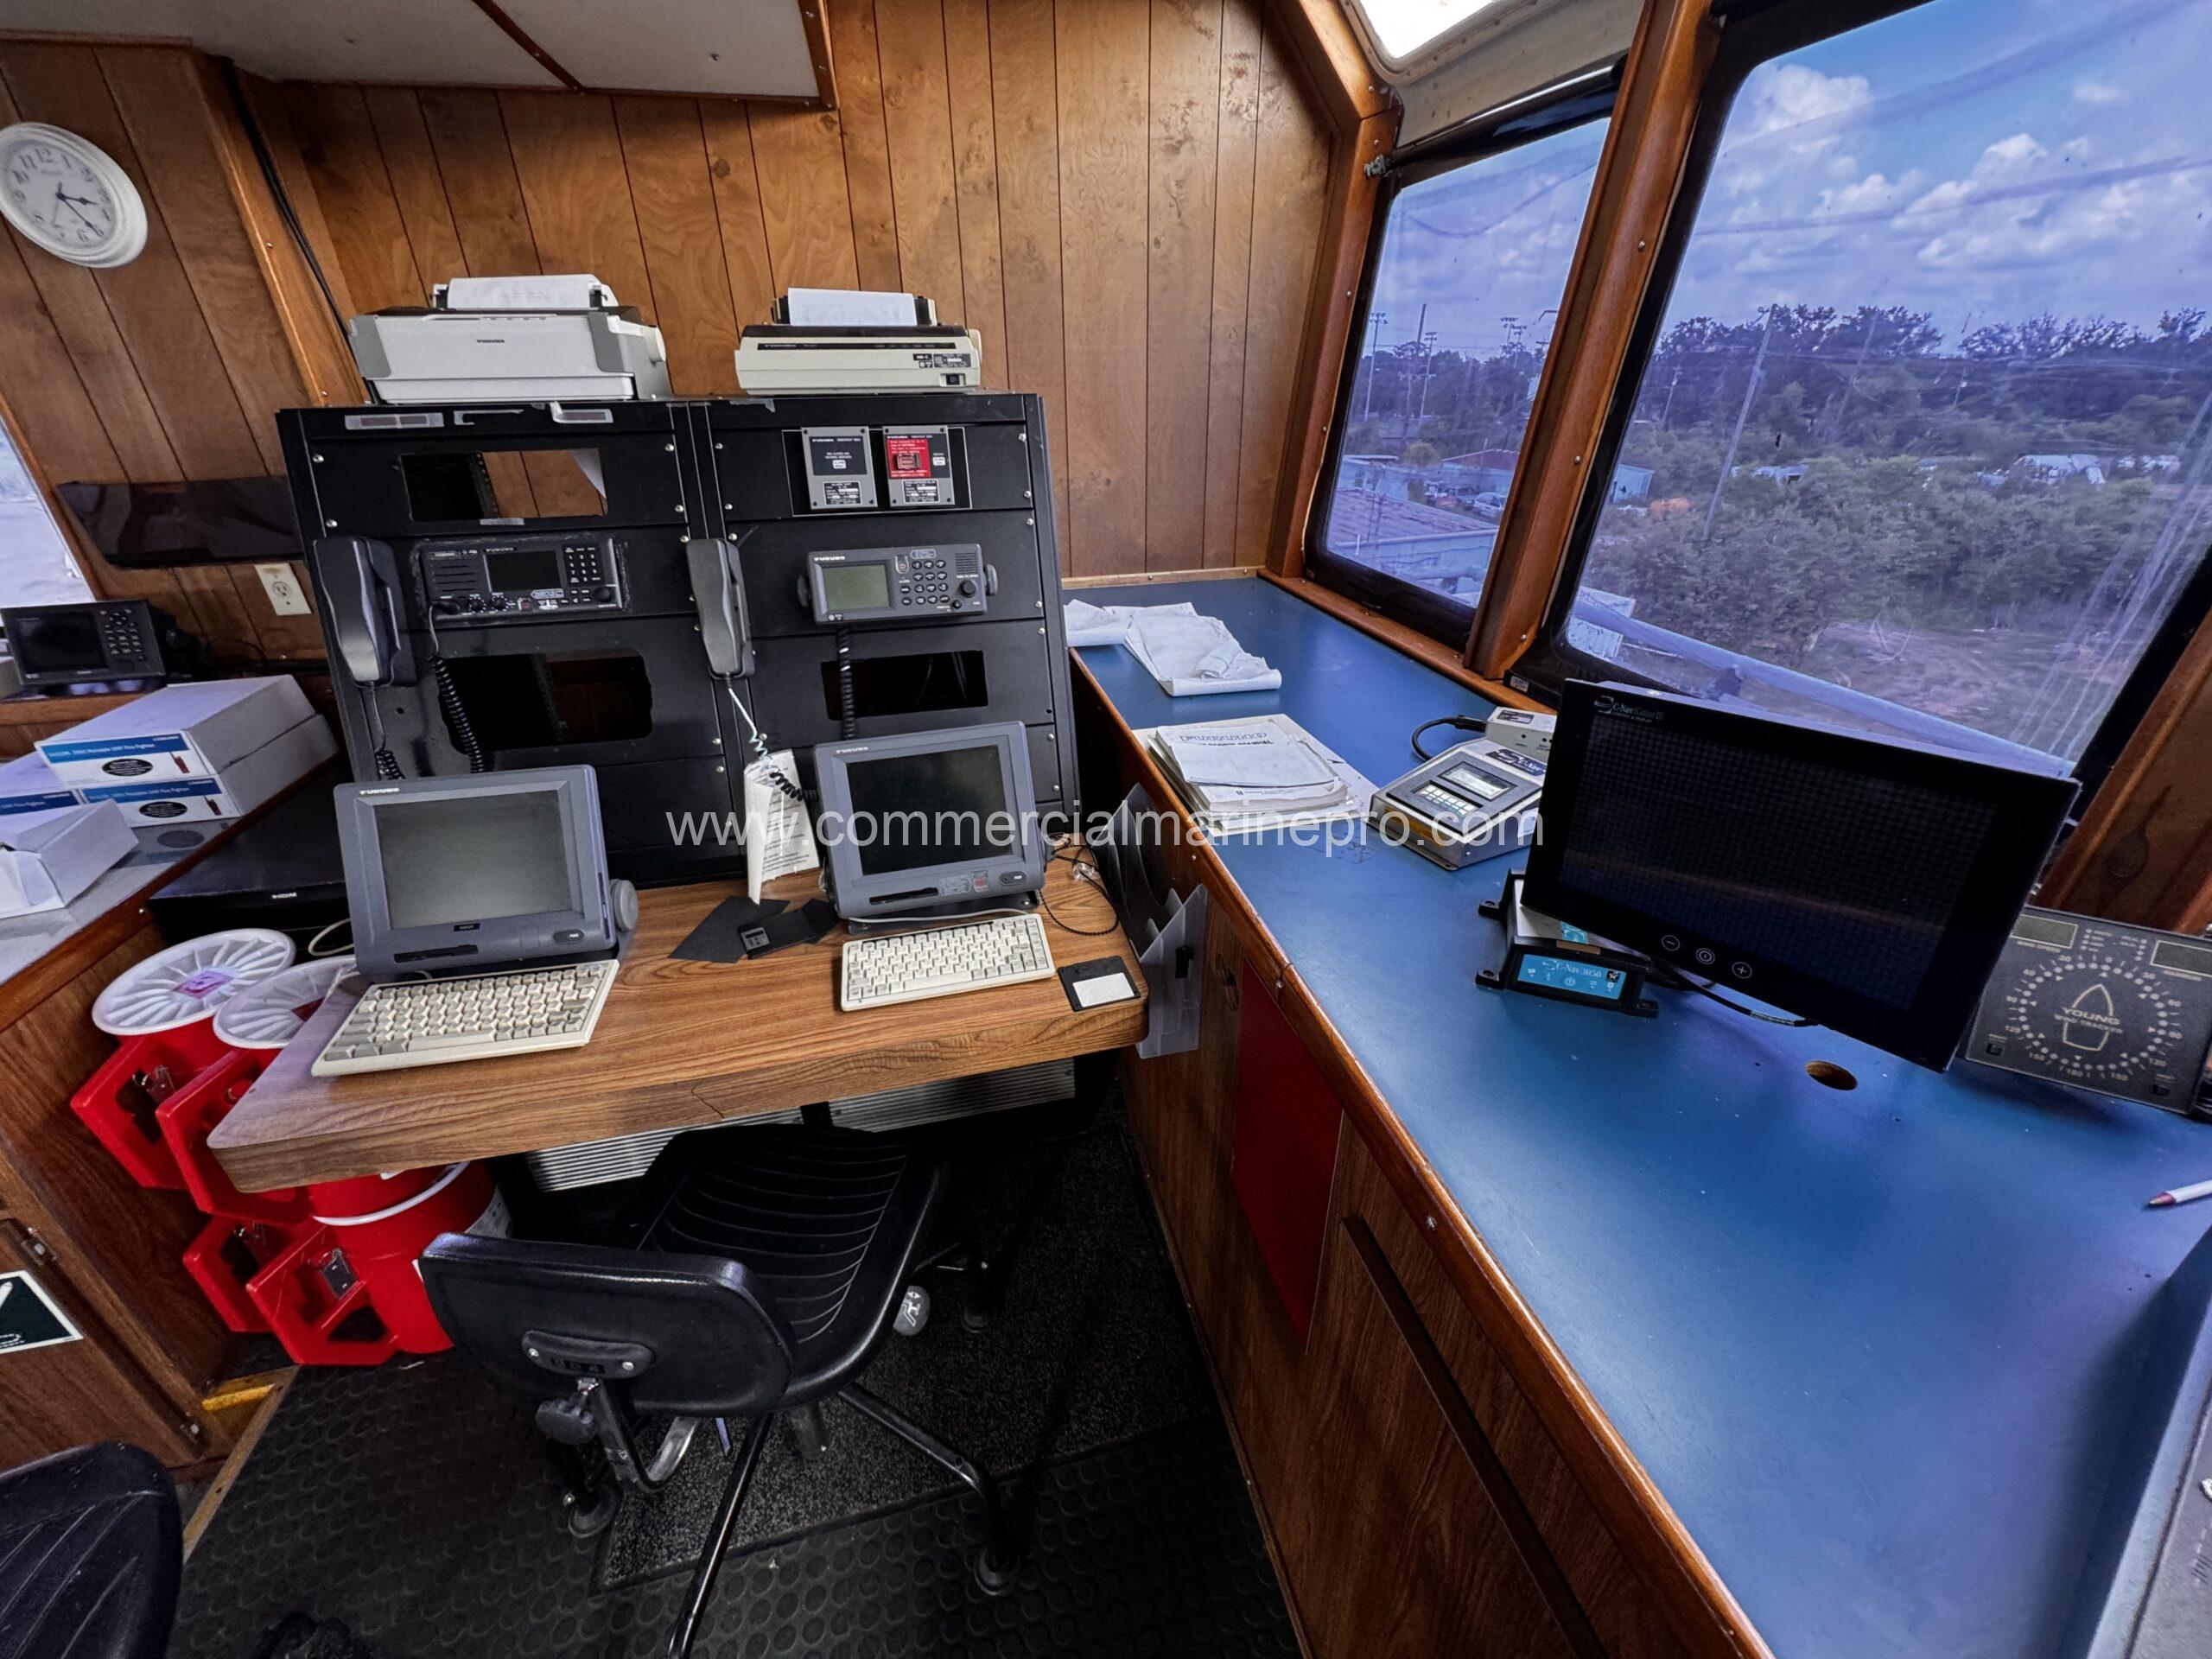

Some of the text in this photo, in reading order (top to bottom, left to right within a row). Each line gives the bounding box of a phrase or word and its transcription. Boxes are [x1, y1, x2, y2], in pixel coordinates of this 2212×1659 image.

[19, 156, 38, 169] 11
[35, 148, 54, 163] 12
[835, 746, 869, 754] FURUNO
[2061, 1005, 2122, 1027] YOUNG
